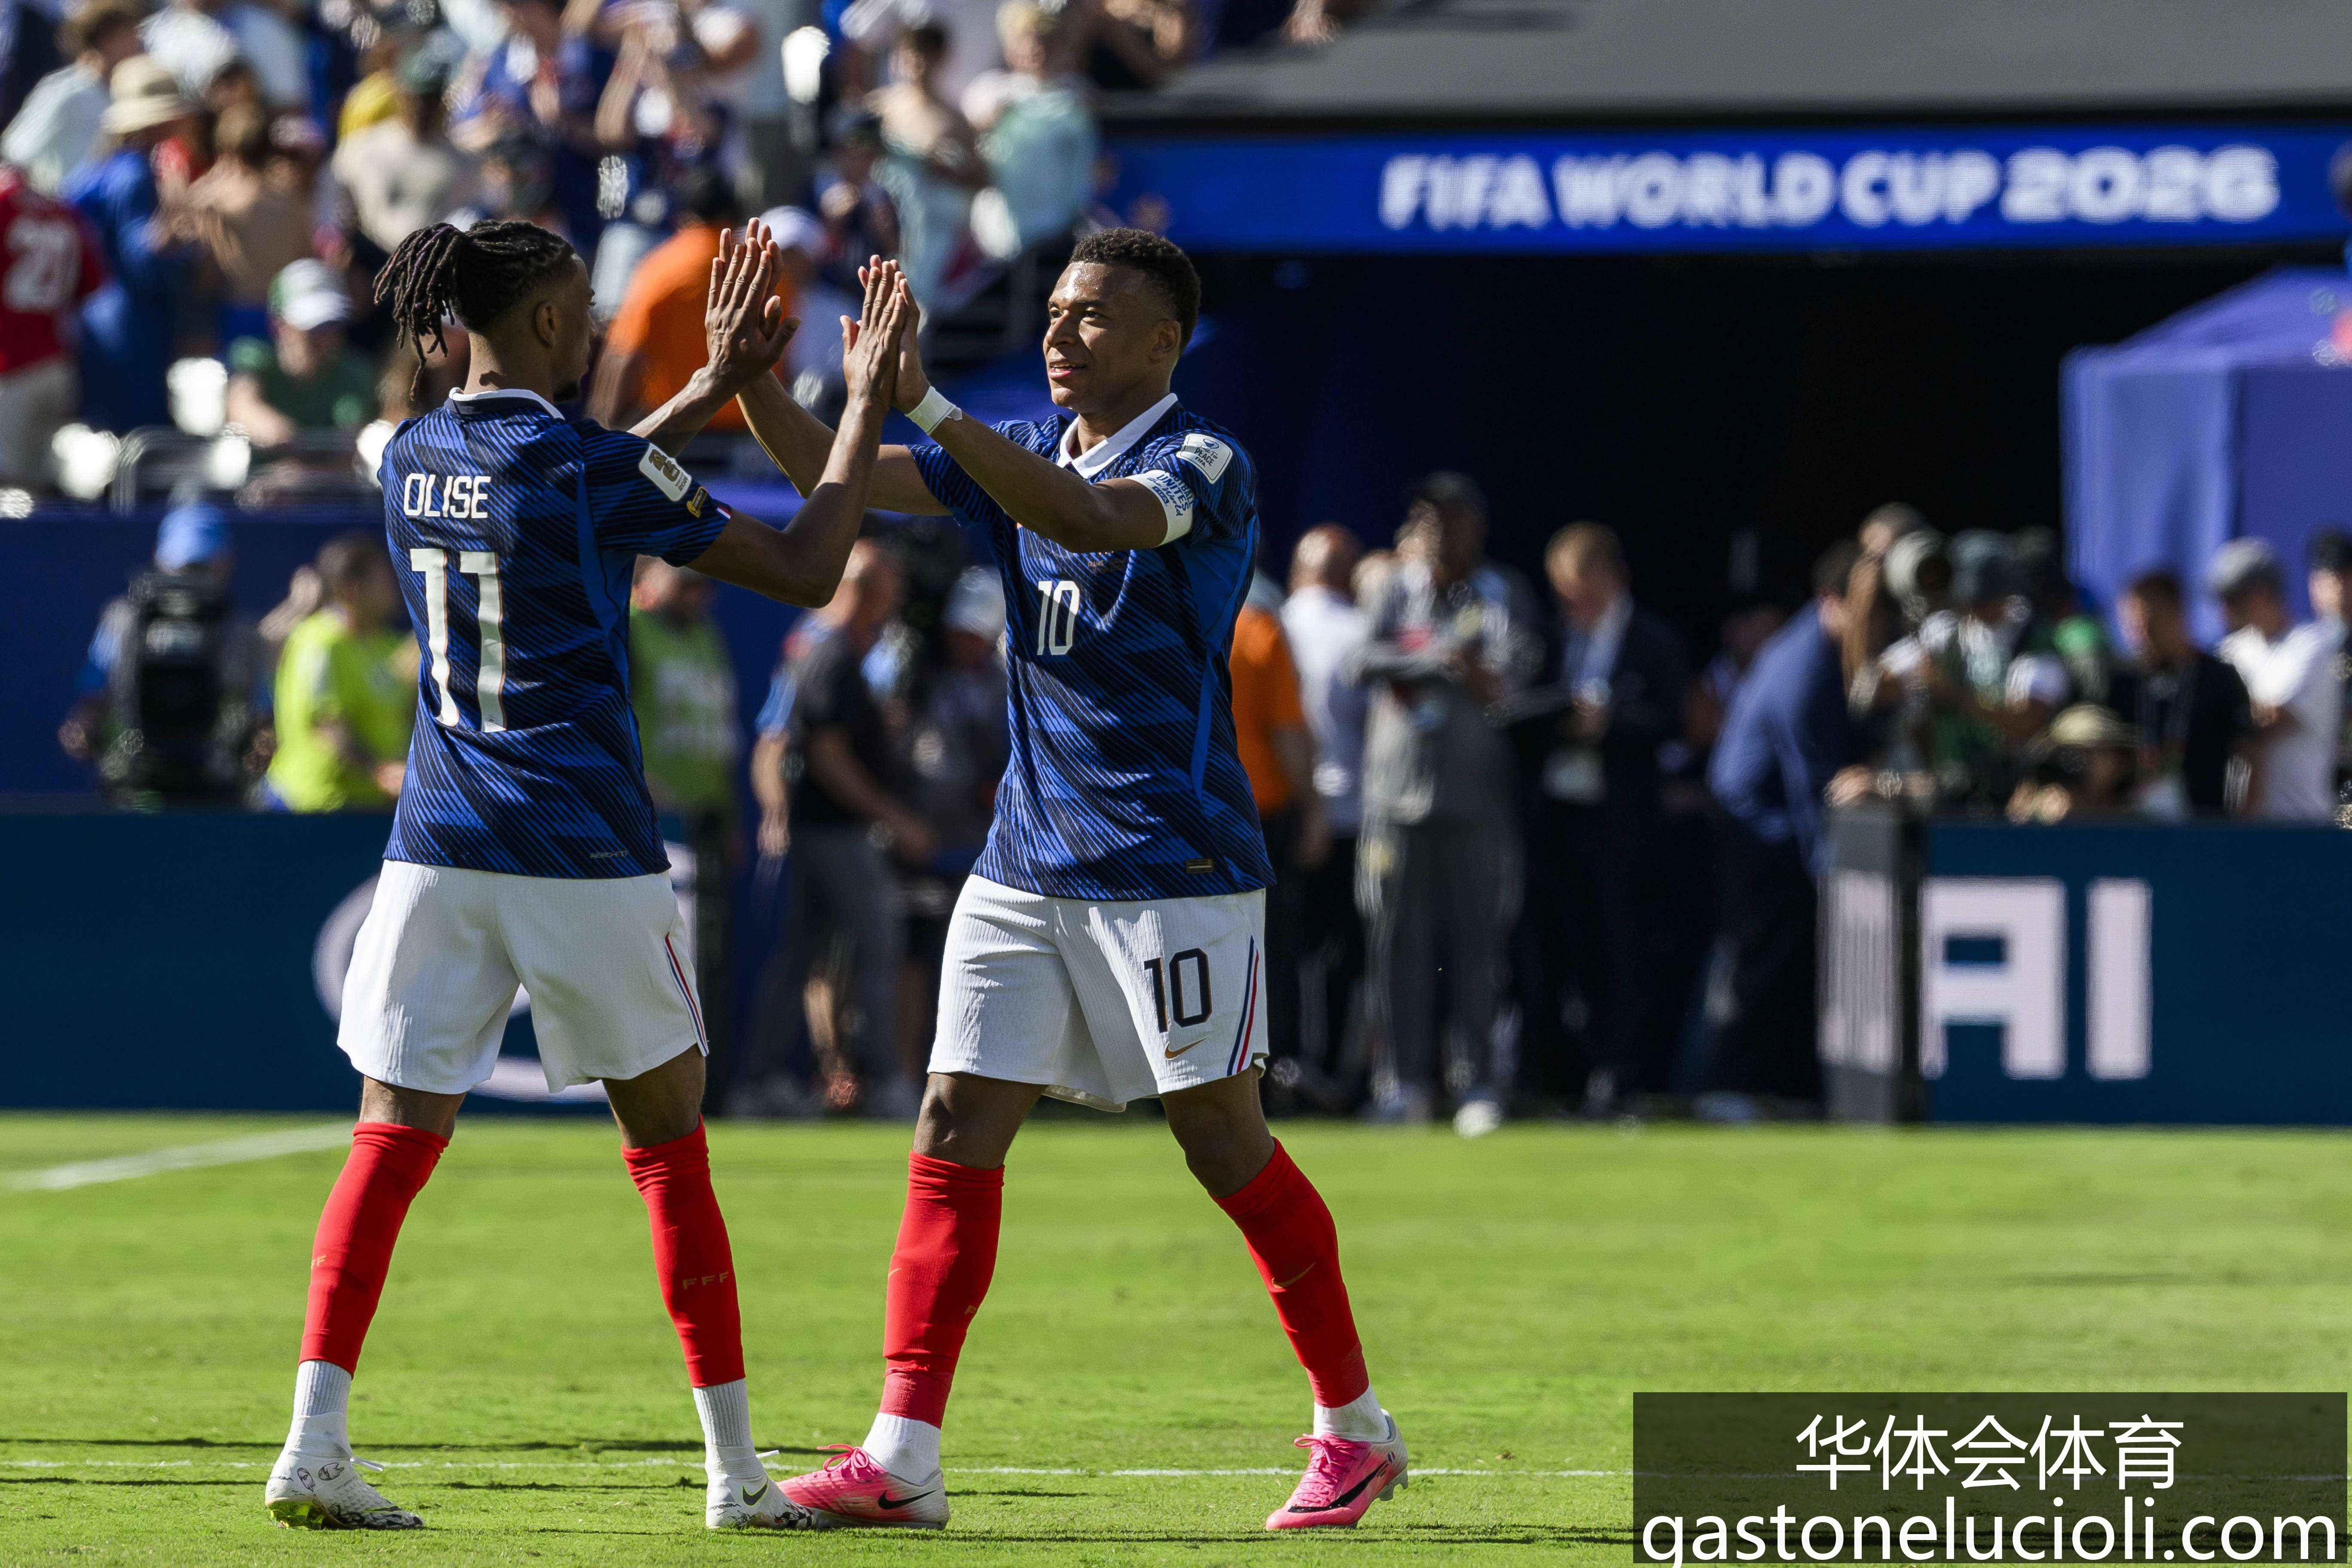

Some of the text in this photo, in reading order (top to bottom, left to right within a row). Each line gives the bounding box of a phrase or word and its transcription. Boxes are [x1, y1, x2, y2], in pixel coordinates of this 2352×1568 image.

[1380, 145, 2280, 229] FIFA WORLD CUP 2026
[1194, 447, 1215, 467] PEACE
[403, 473, 491, 519] OLISE
[1156, 474, 1189, 511] UNITES
[410, 548, 507, 732] 11
[1037, 581, 1080, 655] 10
[1144, 947, 1213, 1033] 10
[683, 1271, 729, 1290] FFF
